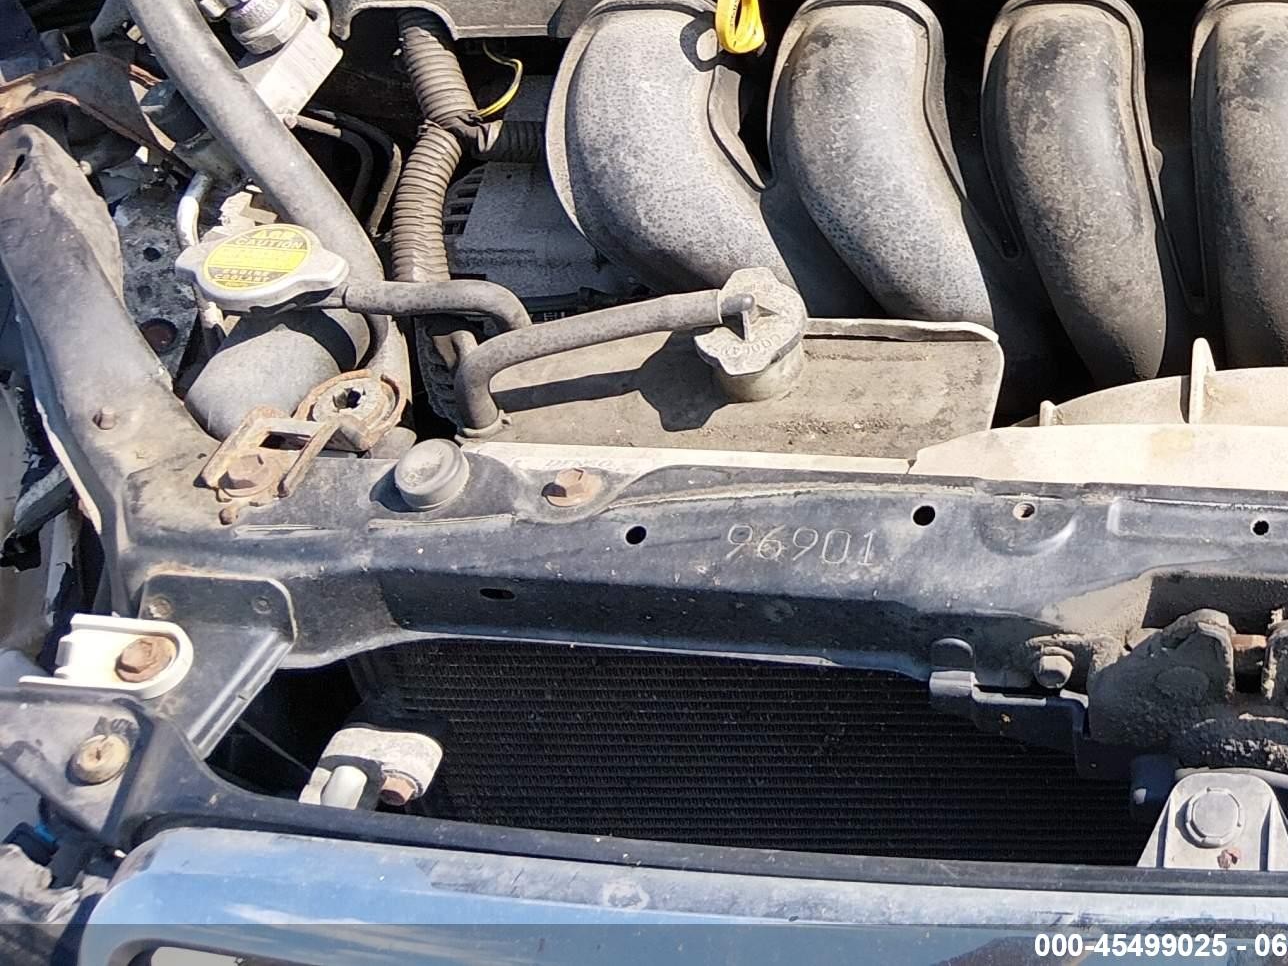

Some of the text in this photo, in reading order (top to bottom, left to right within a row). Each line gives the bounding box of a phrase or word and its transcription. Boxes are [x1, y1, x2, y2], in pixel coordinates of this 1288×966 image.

[235, 237, 303, 249] CAUTION
[214, 274, 270, 282] COOLANT
[725, 523, 878, 565] 96901
